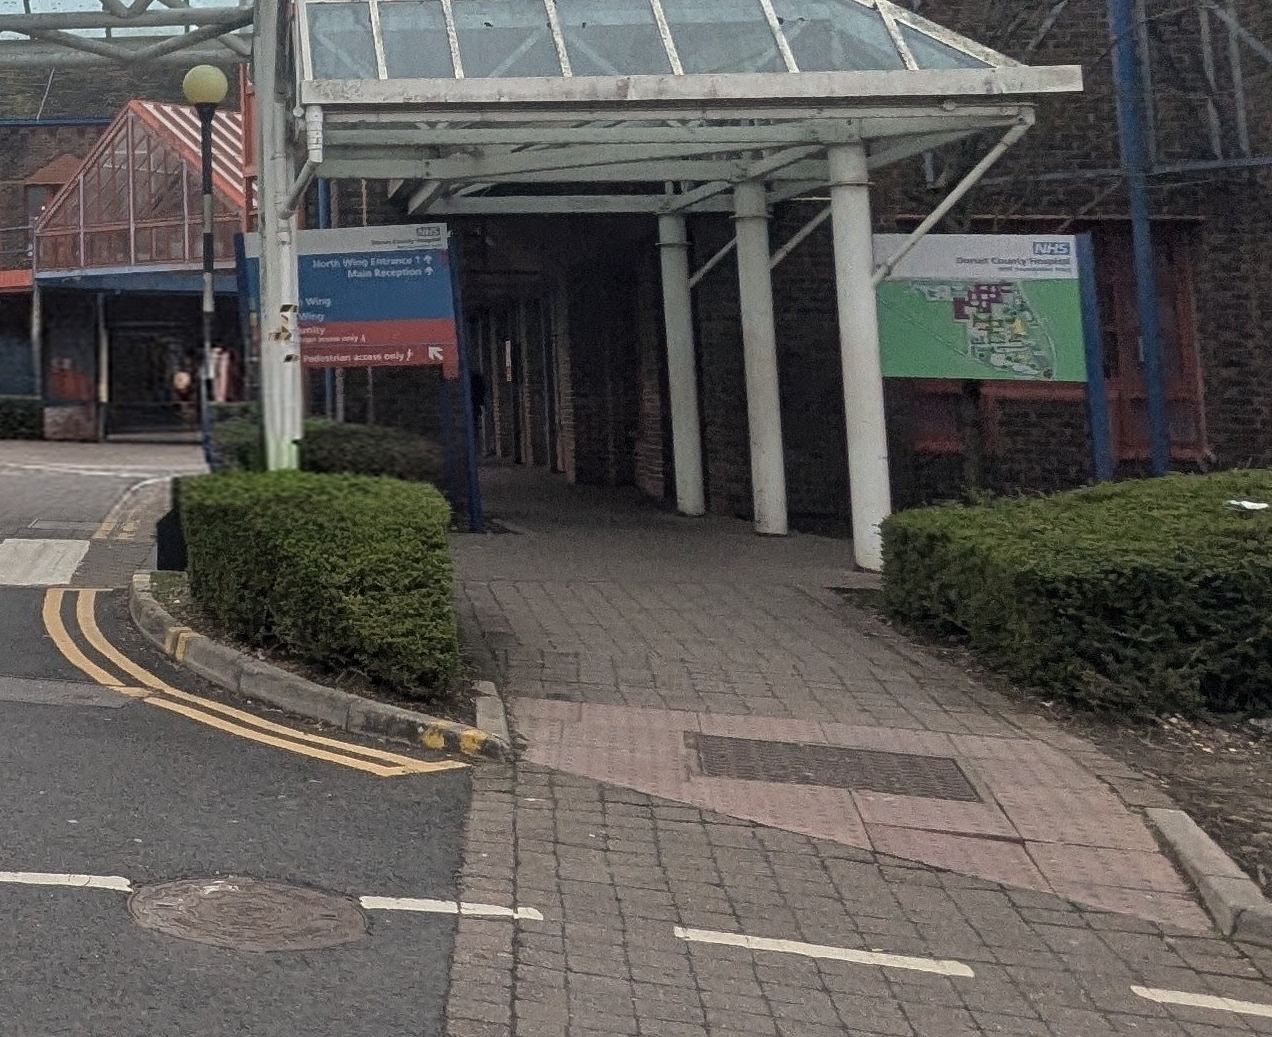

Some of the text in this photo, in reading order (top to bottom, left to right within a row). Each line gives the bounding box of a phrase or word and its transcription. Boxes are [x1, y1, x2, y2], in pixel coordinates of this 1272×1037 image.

[1034, 242, 1070, 255] NHS
[312, 259, 341, 269] North
[342, 258, 369, 268] Wing
[370, 256, 413, 266] Entrance
[990, 257, 1027, 266] County
[347, 267, 423, 278] Main Reception
[305, 297, 332, 308] Wing
[303, 351, 404, 363] Pedestrian access only
